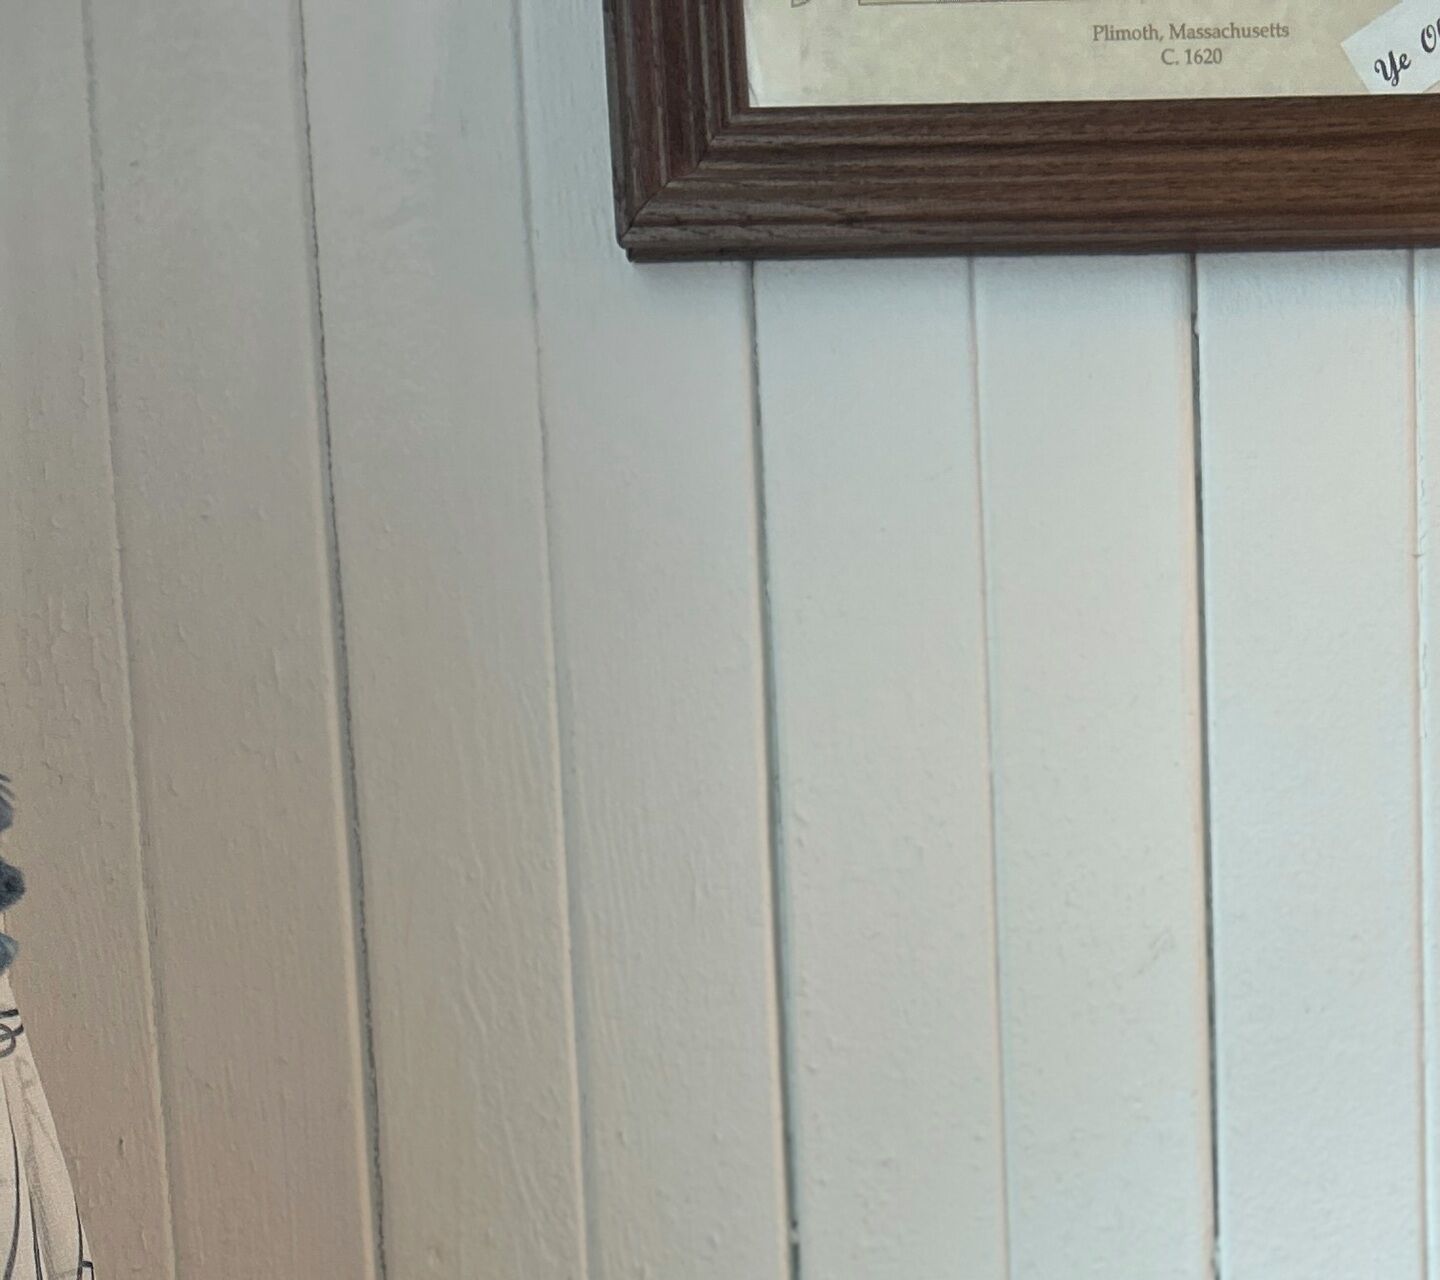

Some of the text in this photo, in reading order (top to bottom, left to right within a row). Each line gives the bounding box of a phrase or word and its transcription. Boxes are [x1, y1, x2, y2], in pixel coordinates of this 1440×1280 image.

[1093, 22, 1290, 42] Plimoth, Massachusetts
[1161, 48, 1222, 65] C. 1620
[1374, 50, 1411, 87] Ye
